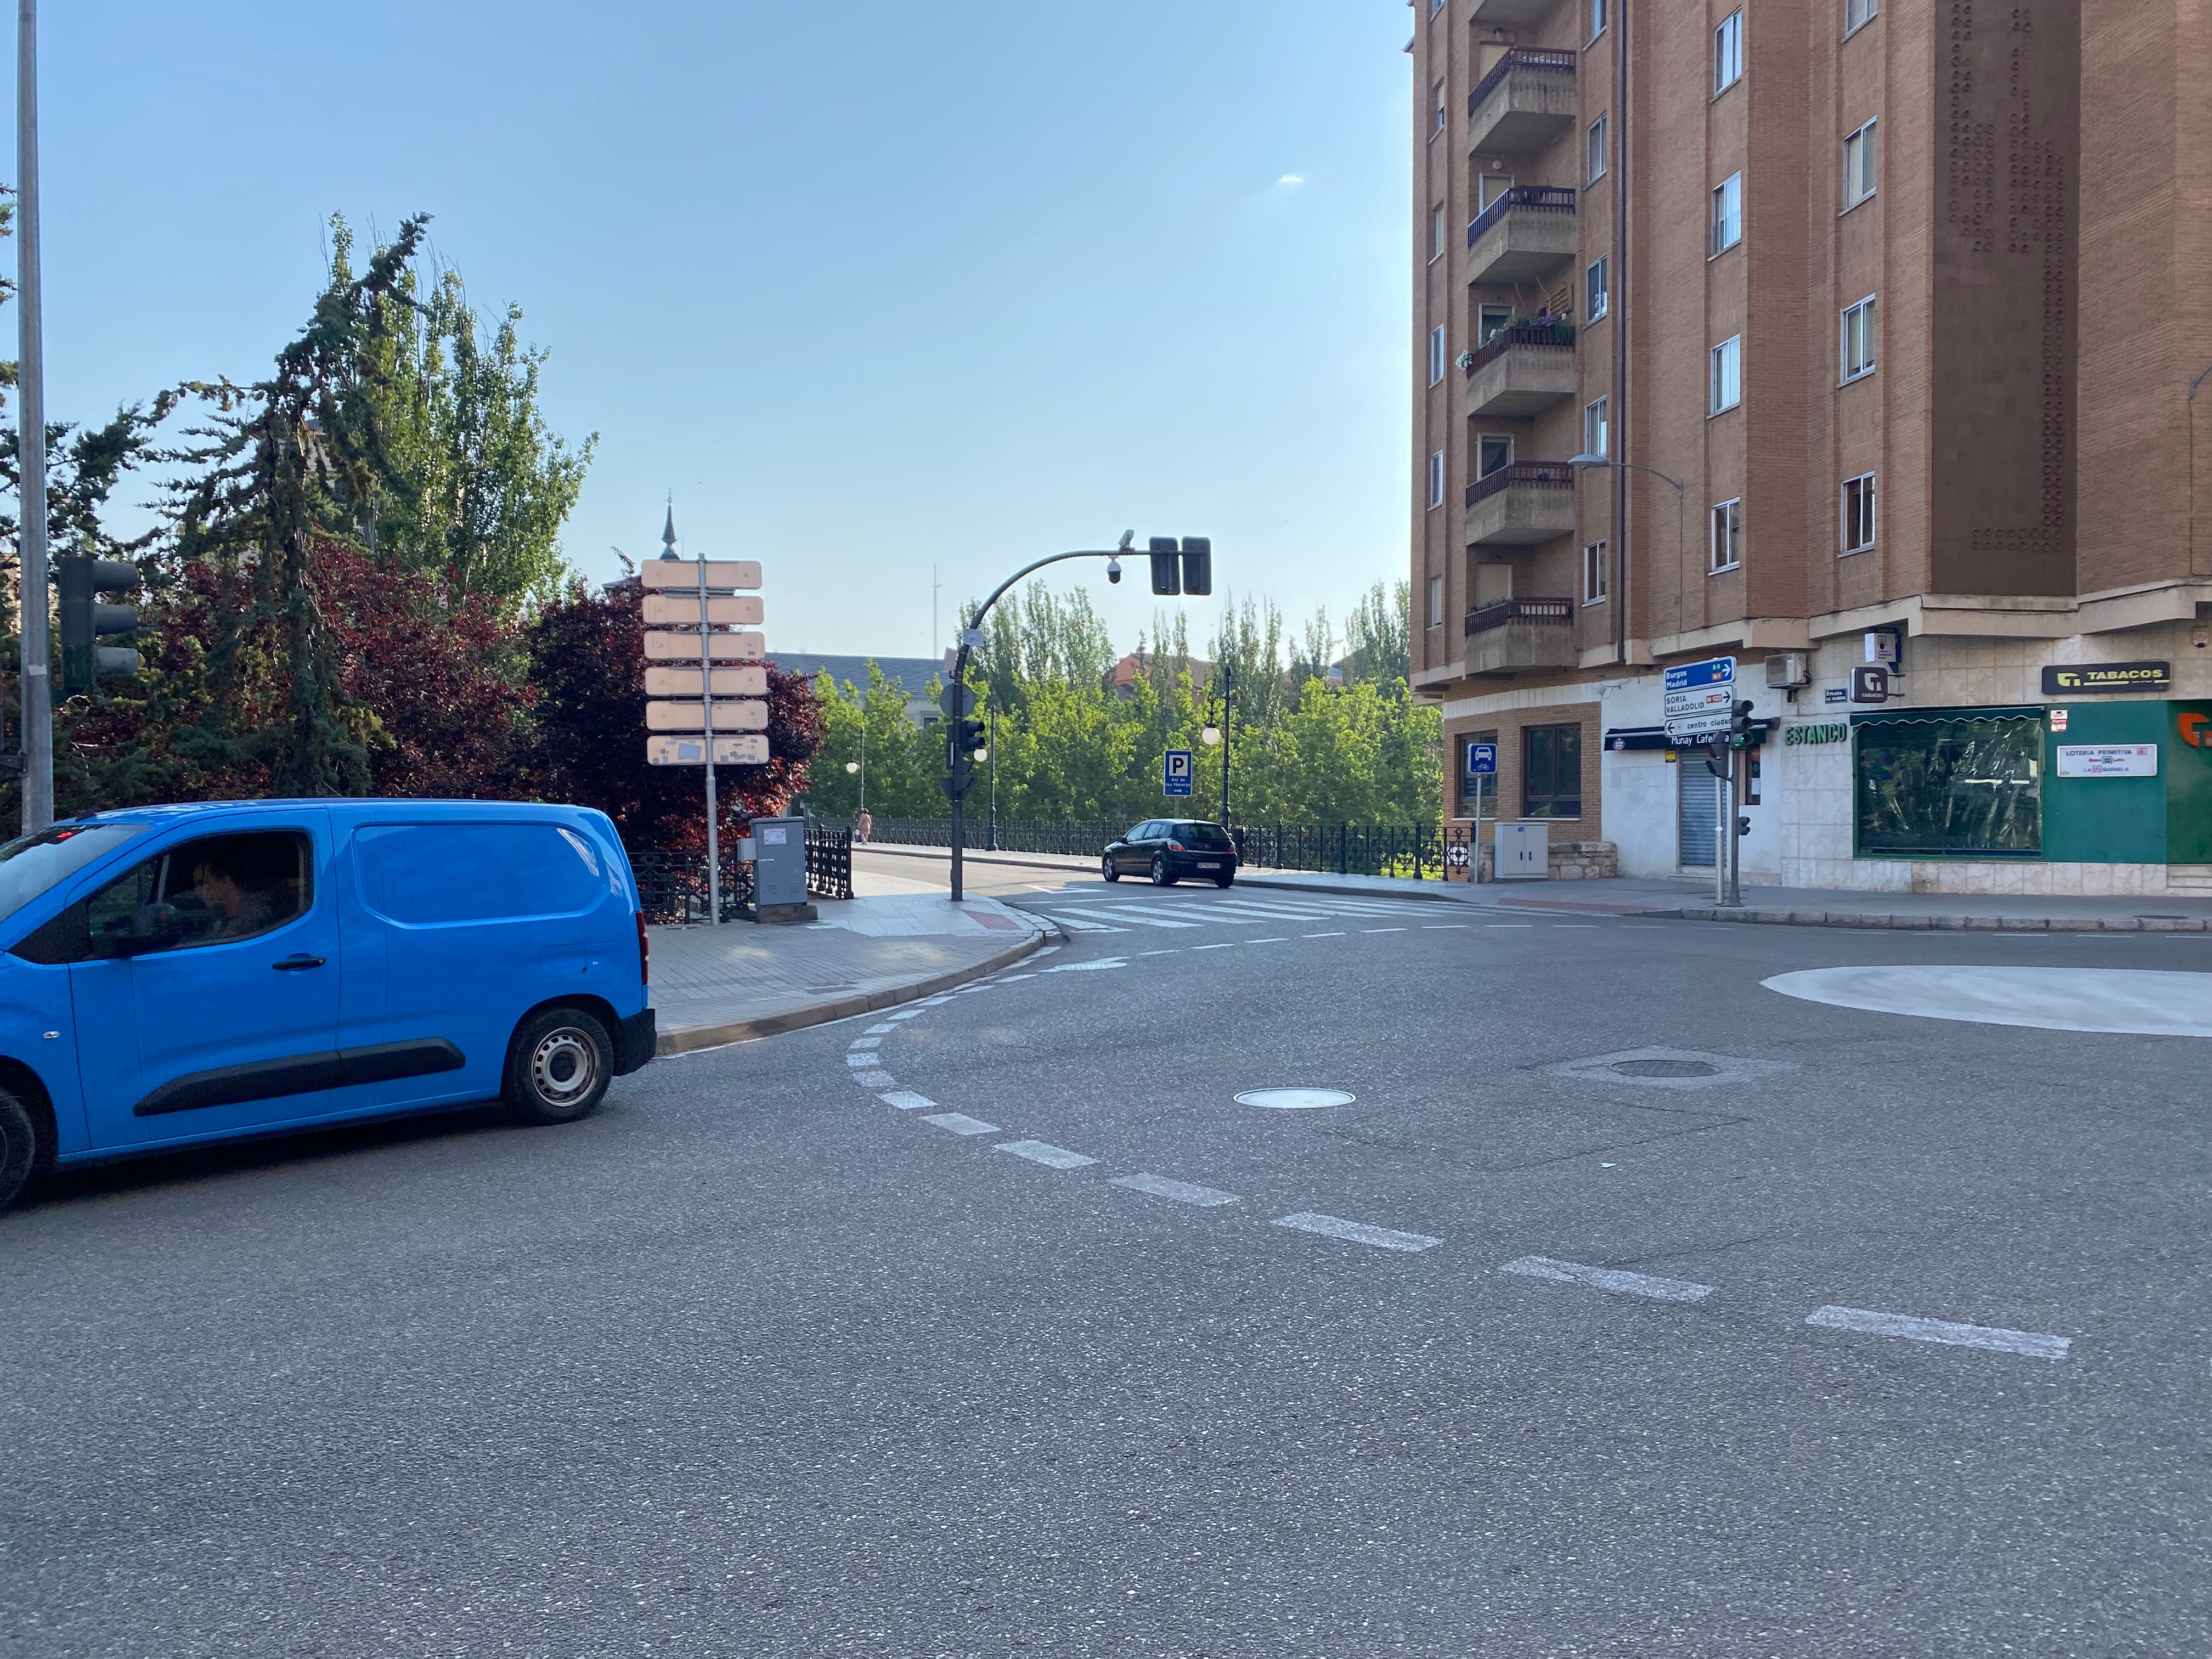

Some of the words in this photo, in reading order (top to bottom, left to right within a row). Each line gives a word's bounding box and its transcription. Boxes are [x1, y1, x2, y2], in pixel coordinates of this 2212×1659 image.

[1666, 670, 1688, 680] Burgos
[2087, 670, 2163, 679] TABACOS
[1667, 679, 1688, 689] Madrid
[1667, 695, 1687, 704] SORIA
[1707, 695, 1722, 703] N-122
[1667, 702, 1705, 713] VALLADOLID
[1785, 723, 1847, 746] ESTANCO
[1672, 737, 1692, 746] Munay
[1172, 757, 1184, 774] P
